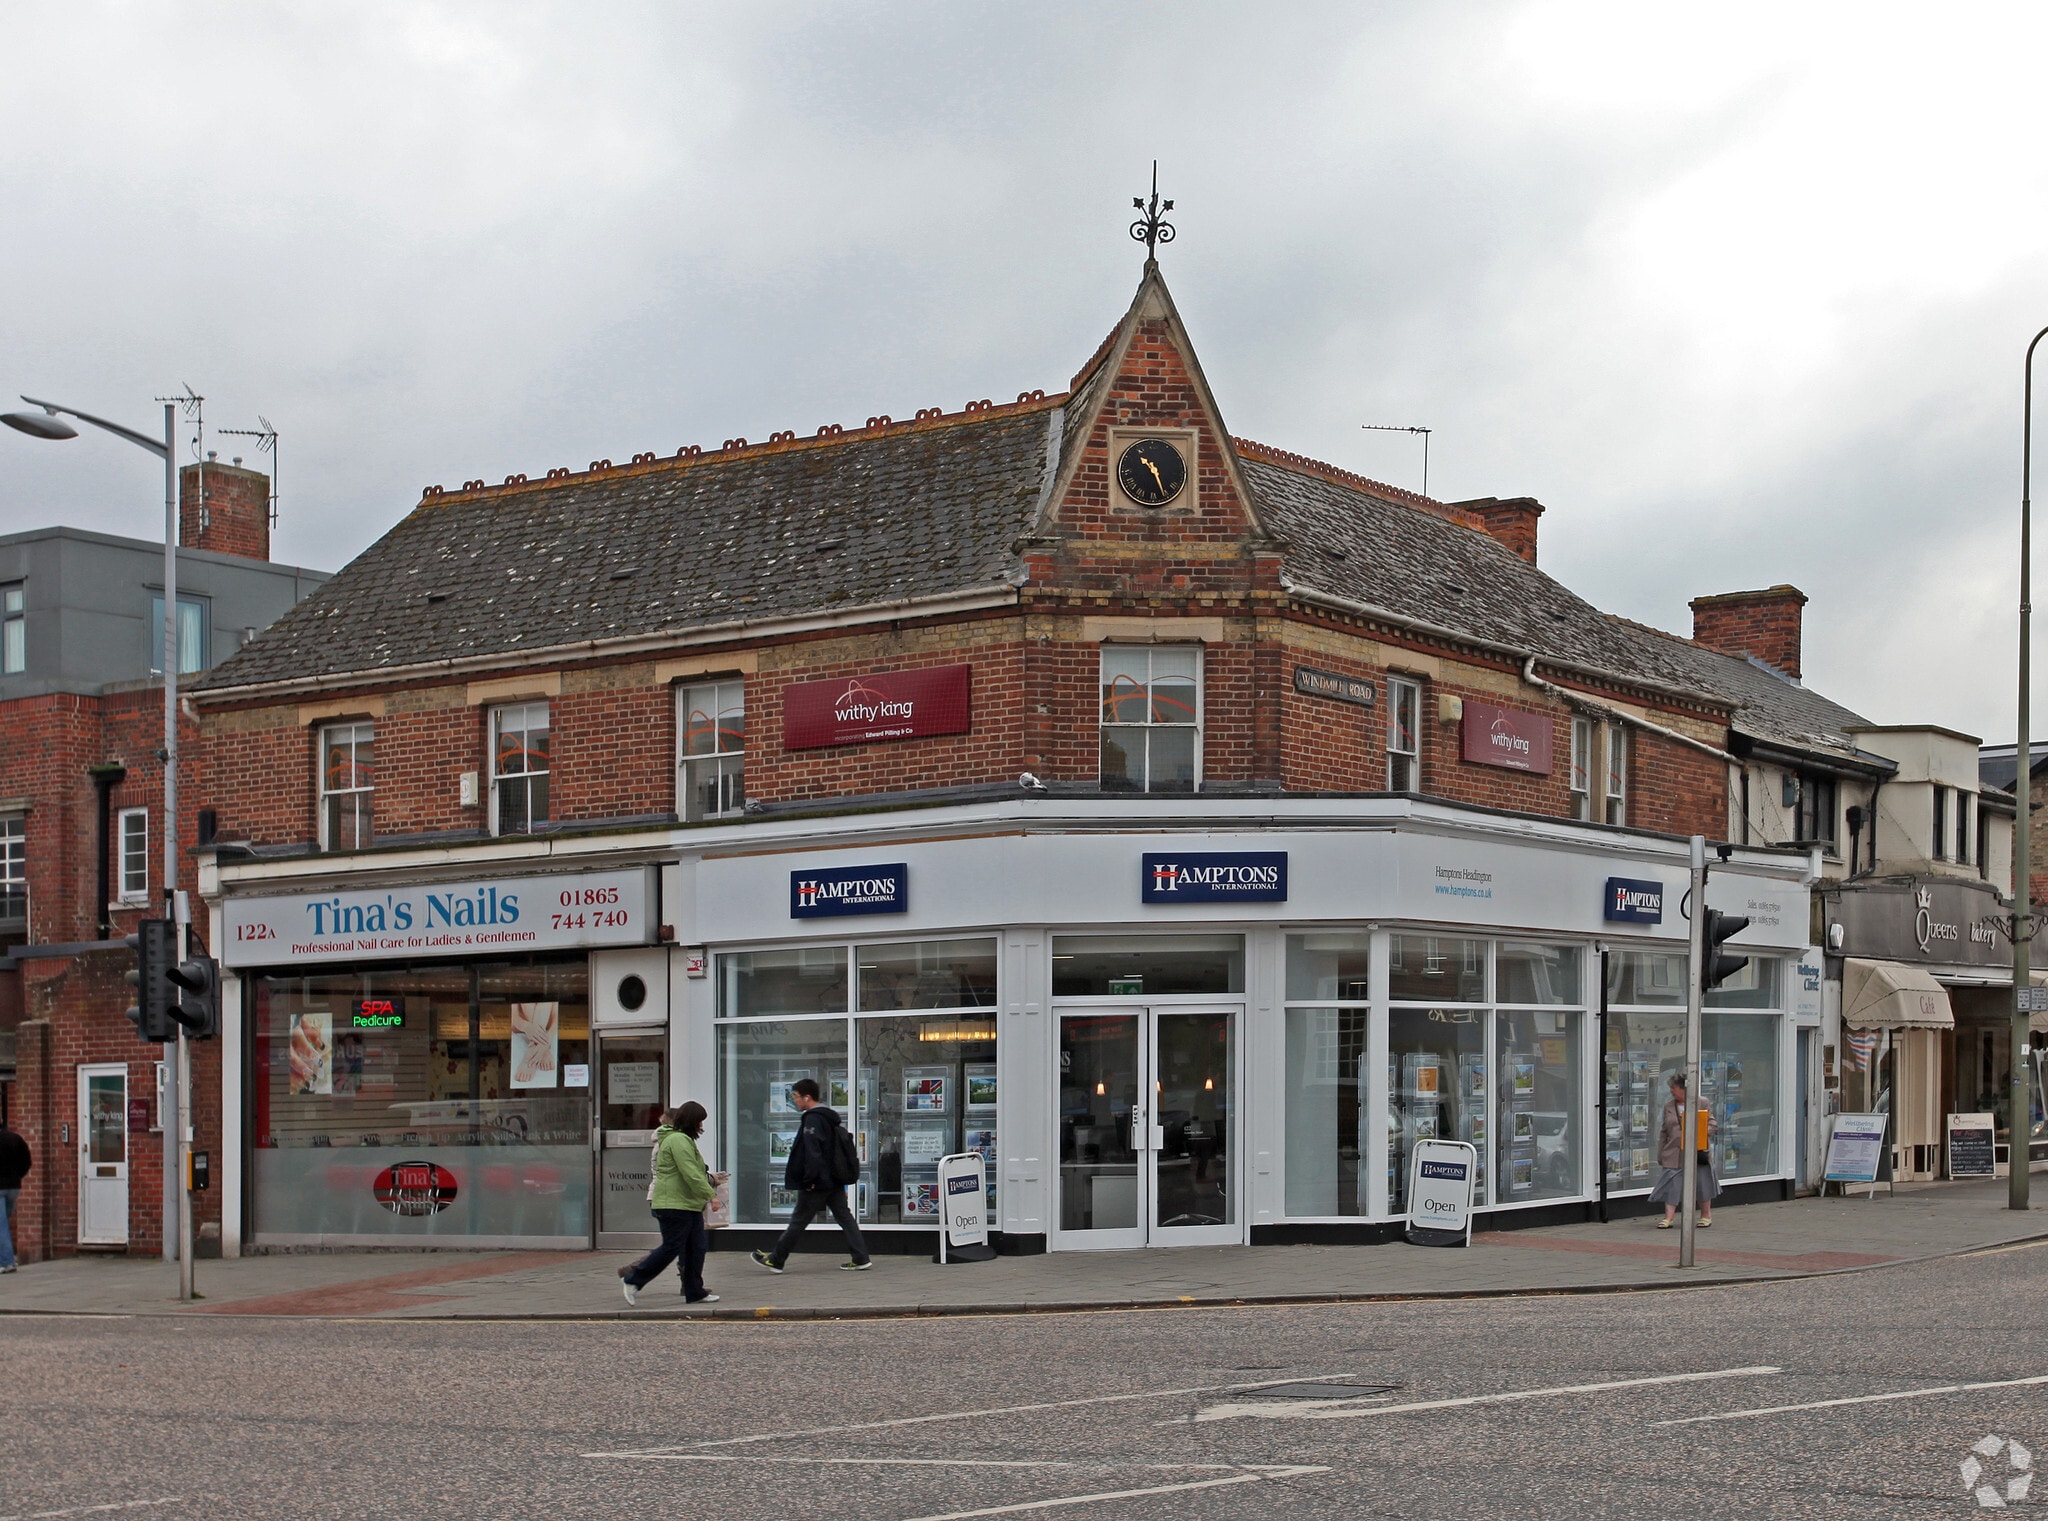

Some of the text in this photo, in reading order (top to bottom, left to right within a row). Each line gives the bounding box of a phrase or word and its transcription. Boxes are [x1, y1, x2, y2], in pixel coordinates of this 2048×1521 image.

[1301, 672, 1372, 700] WINDMILL ROAD
[834, 700, 914, 722] withy king
[1490, 732, 1529, 755] withy king
[1152, 863, 1278, 892] HAMPTONS
[1435, 865, 1492, 885] Hamptons Headington
[559, 886, 619, 907] 01865
[798, 877, 895, 908] HAMPTONS
[1211, 883, 1278, 891] INTERNATIONAL
[1434, 884, 1492, 900] www.hamptons.co.uk
[842, 894, 896, 904] INTERNATIONAL
[1615, 887, 1660, 911] HAMPTONS
[306, 886, 520, 936] Tina's Nails
[551, 909, 628, 930] 744 740
[237, 922, 276, 941] 122A
[1915, 908, 1997, 954] Queens bakery
[291, 930, 536, 955] Professional Nail Care for Ladies & Gentlemen
[360, 1000, 395, 1016] SPA
[1919, 995, 1936, 1015] Café
[353, 1014, 402, 1028] Pedicure
[92, 1110, 123, 1122] withy king
[608, 1171, 648, 1180] Welcome
[1424, 1164, 1464, 1175] HAMPTONS
[949, 1179, 977, 1192] HAMPTONS
[1424, 1198, 1456, 1214] Open
[955, 1215, 978, 1230] Open
